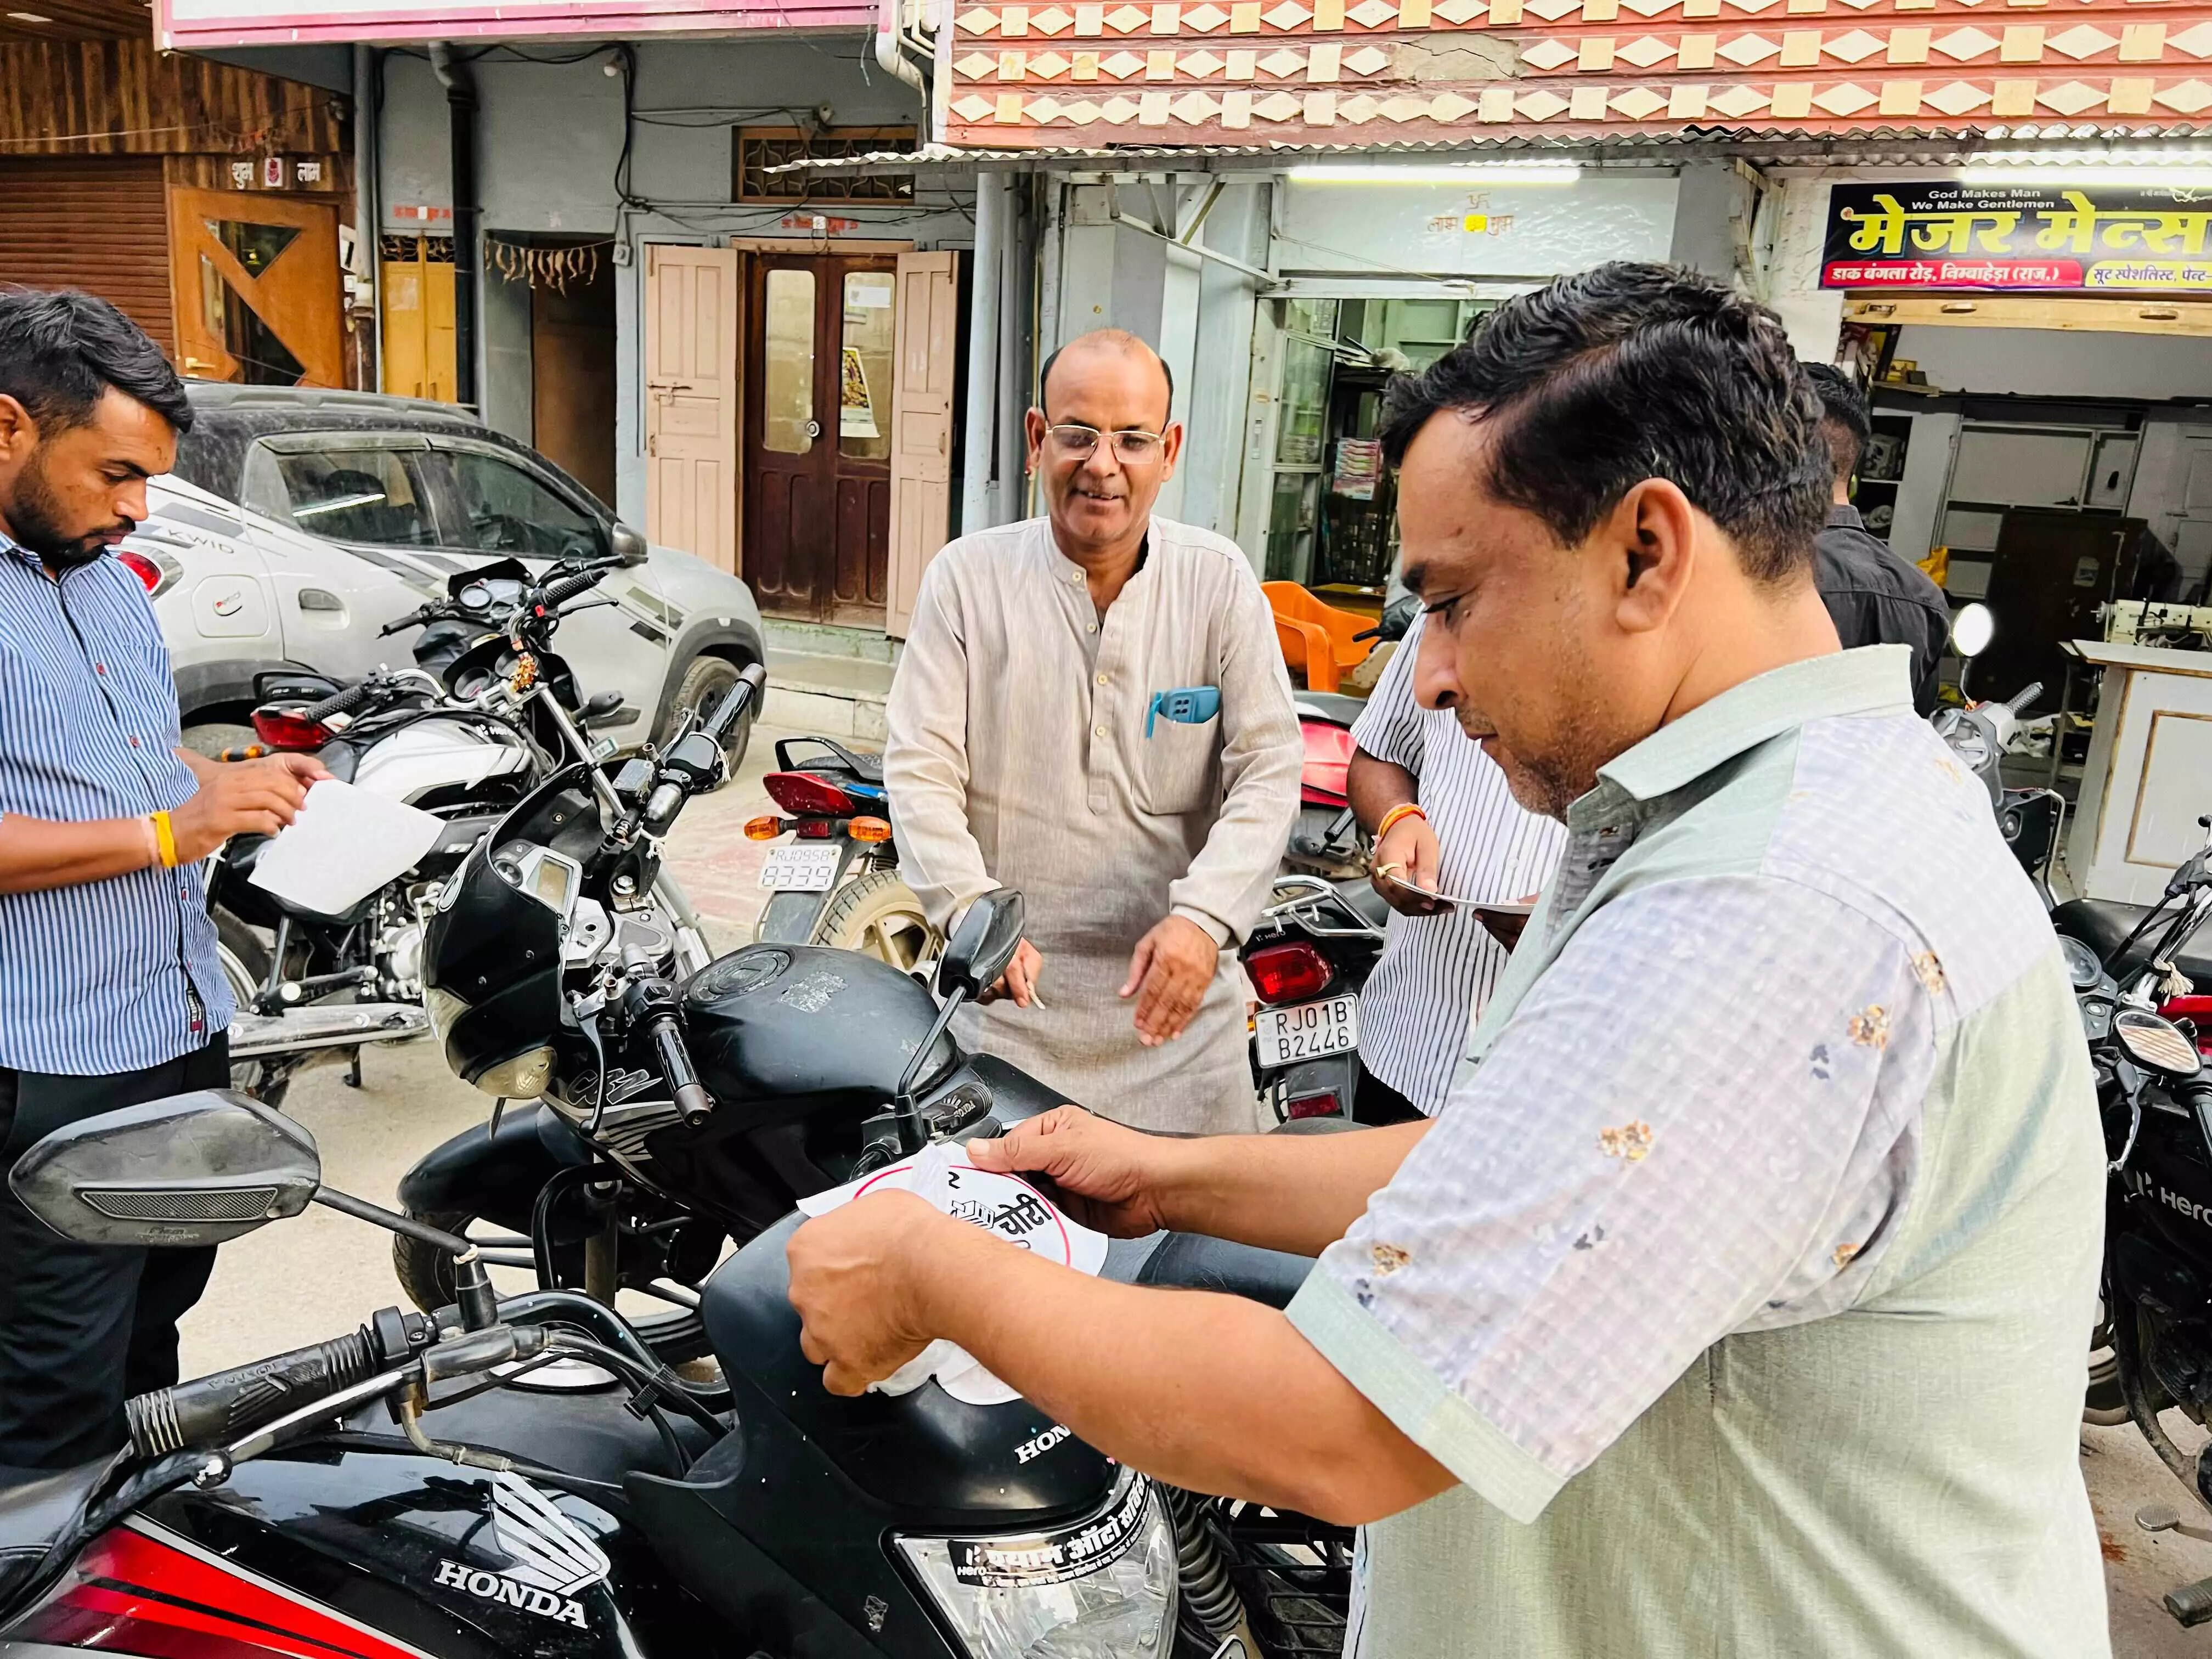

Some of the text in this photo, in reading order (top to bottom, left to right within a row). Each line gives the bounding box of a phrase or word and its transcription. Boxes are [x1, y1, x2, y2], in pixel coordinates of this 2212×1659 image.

[1912, 200, 2055, 210] We Make Gentlemen
[1928, 189, 2040, 199] God Makes Man
[1847, 194, 2021, 253] मेजर
[1832, 267, 1863, 280] डाक
[168, 529, 234, 554] KWID
[1276, 1001, 1347, 1035] RJ01B
[1278, 1026, 1349, 1060] B2446
[957, 1566, 988, 1576] Hero
[433, 1560, 589, 1629] HONDA
